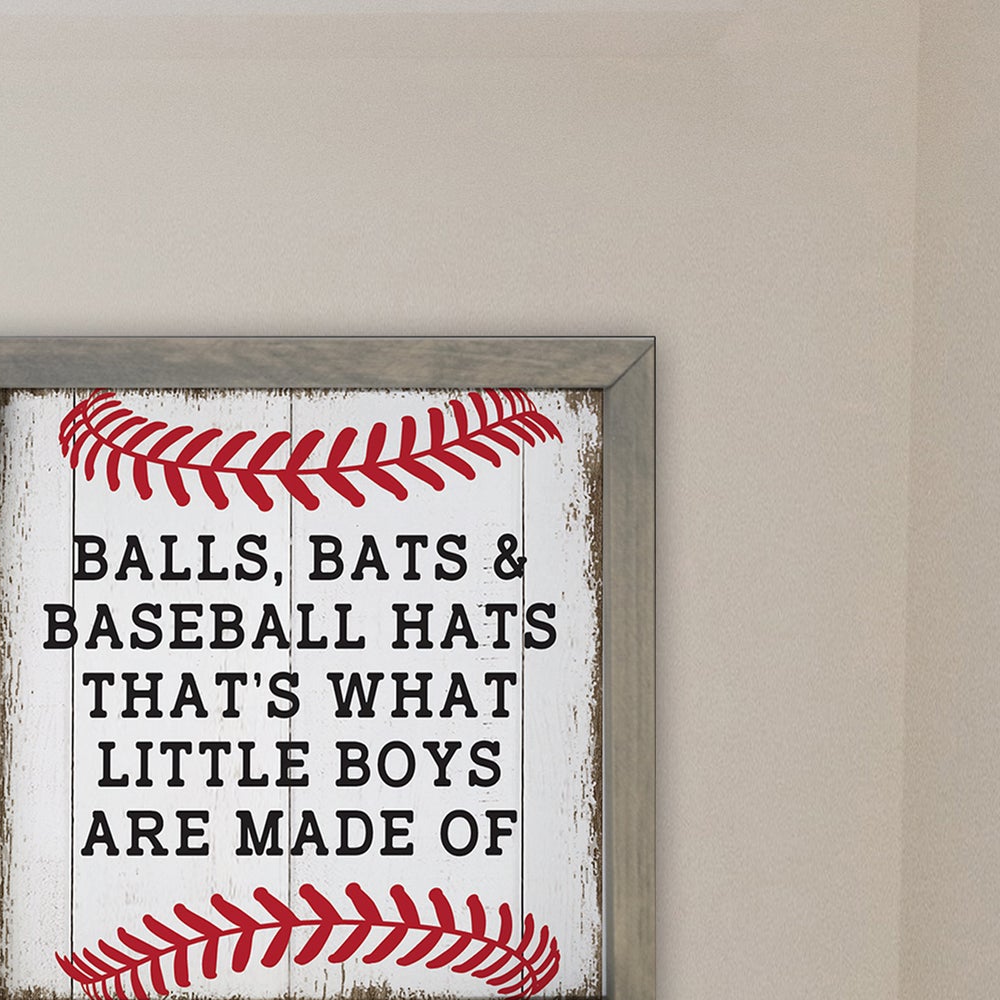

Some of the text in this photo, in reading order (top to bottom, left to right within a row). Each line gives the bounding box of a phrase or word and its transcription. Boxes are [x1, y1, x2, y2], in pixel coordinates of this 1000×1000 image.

[74, 533, 527, 587] BALLS, BATS &
[43, 603, 557, 649] BASEBALL HATS
[82, 672, 517, 718] THAT'S WHAT
[98, 741, 501, 787] LITTLE BOYS
[80, 810, 518, 856] ARE MADE OF
